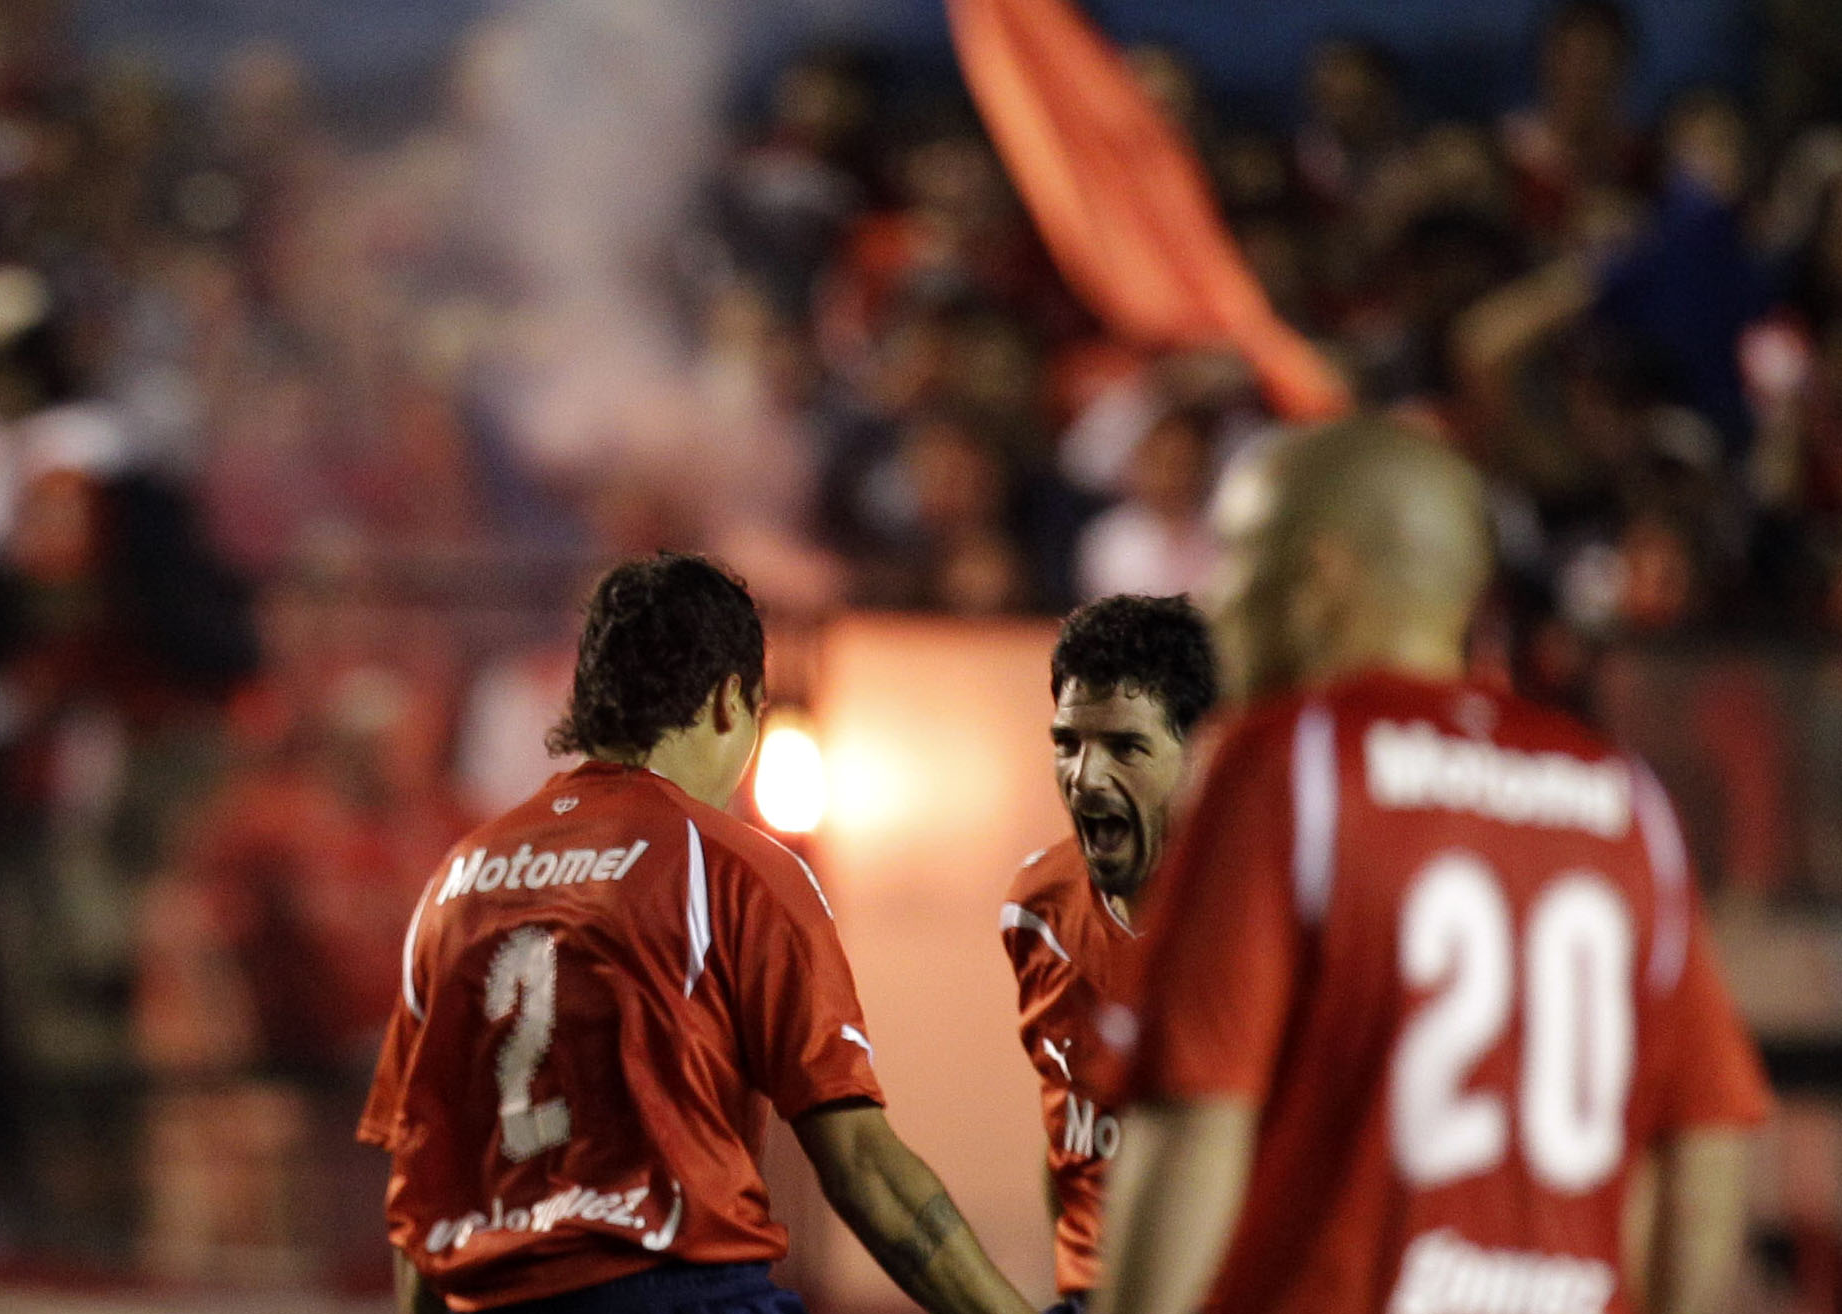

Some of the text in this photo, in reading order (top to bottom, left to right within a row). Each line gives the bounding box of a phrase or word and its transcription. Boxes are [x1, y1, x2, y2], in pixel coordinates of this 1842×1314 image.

[436, 840, 649, 906] Motomel
[484, 925, 571, 1163] 2
[1393, 850, 1633, 1190] 20
